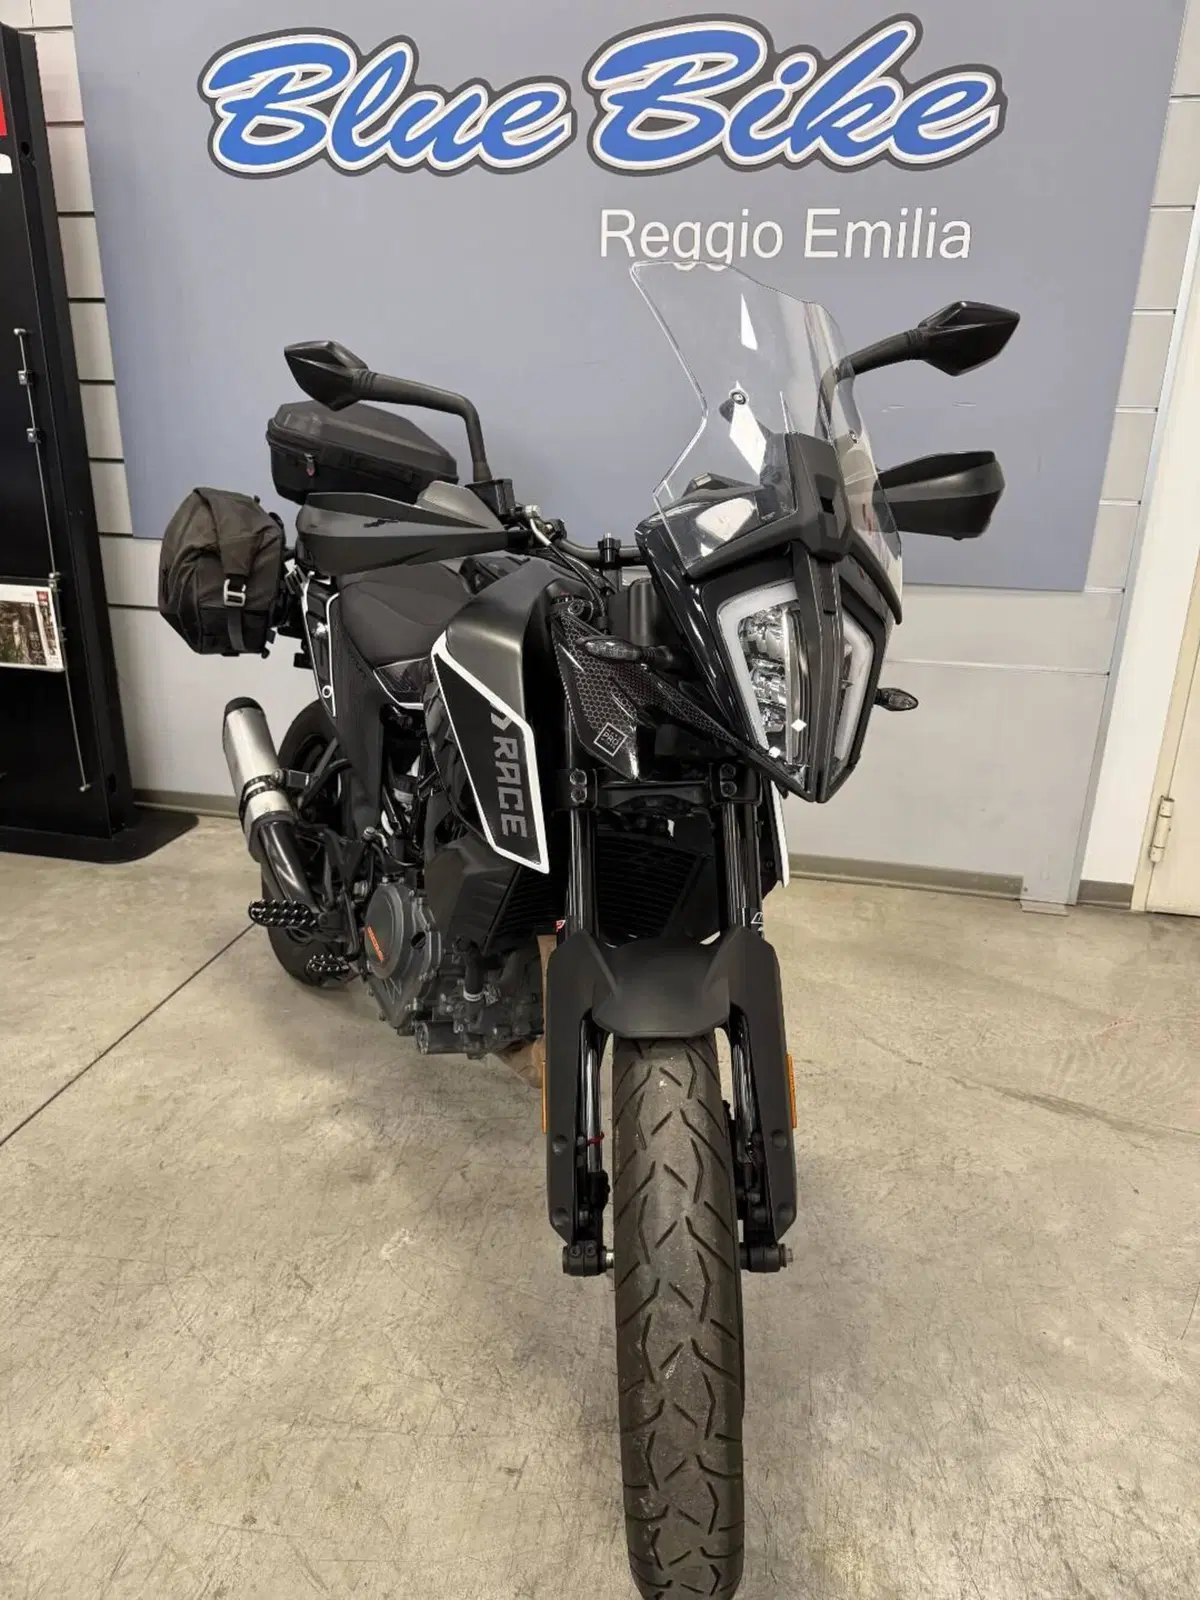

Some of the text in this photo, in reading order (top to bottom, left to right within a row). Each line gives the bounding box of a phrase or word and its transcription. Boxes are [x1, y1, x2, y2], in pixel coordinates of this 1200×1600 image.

[202, 20, 1001, 172] Blue Bike
[601, 207, 972, 271] Reggio Emilia
[493, 736, 528, 838] RACE
